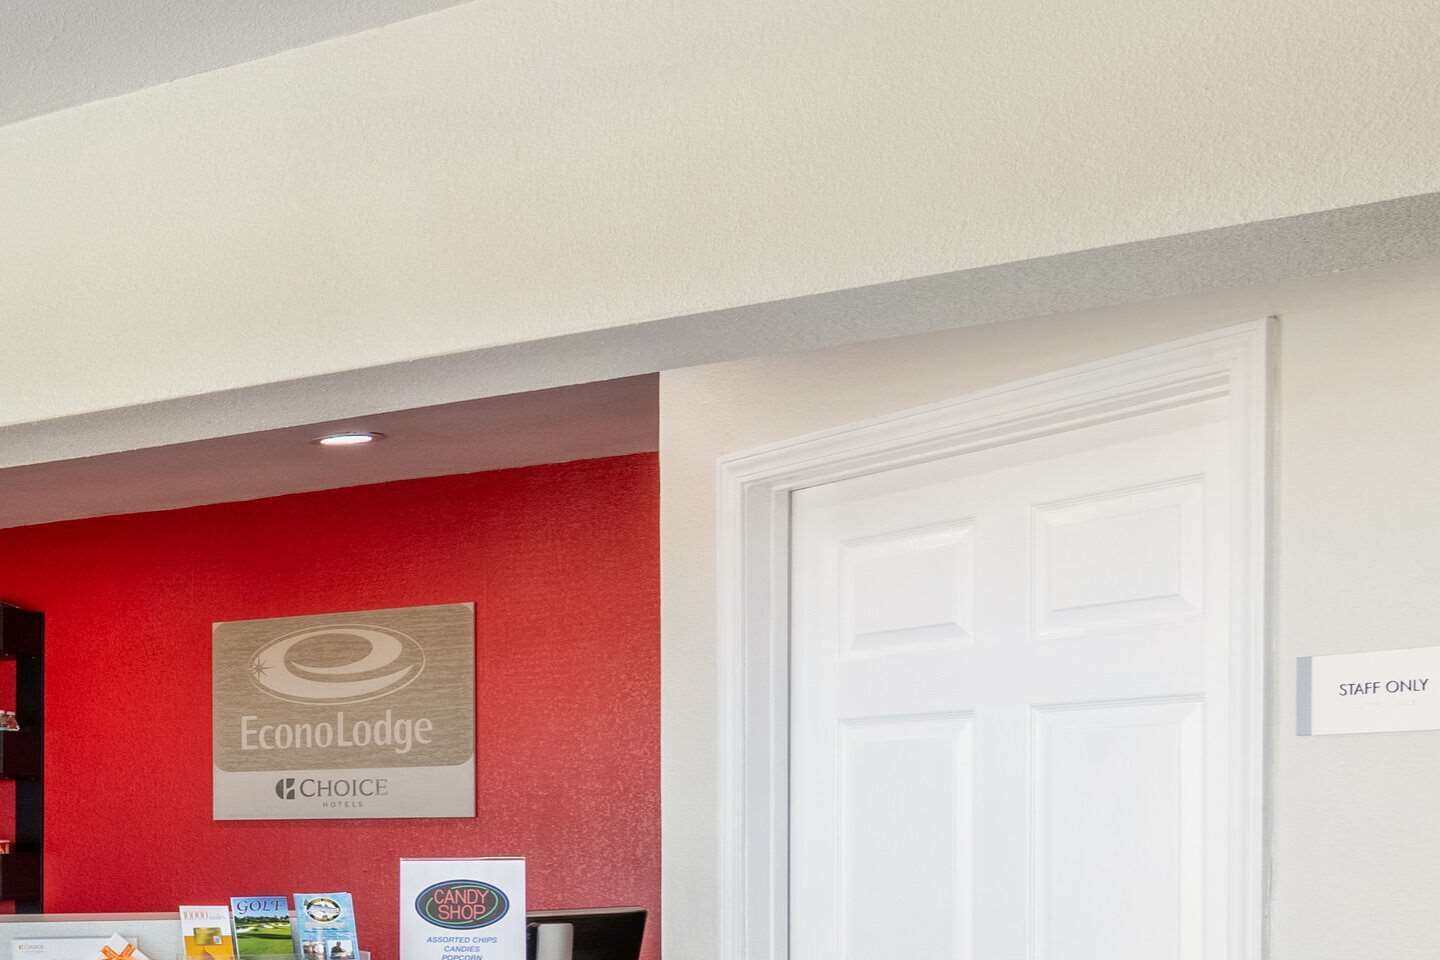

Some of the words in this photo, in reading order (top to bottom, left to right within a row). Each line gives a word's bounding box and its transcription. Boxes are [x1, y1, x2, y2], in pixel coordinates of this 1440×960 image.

[1339, 681, 1380, 697] STAFF
[1385, 678, 1429, 694] ONLY
[240, 709, 433, 754] EconoLodge
[299, 778, 389, 800] CHOICE
[322, 801, 364, 809] HOTELS
[433, 889, 489, 905] CANDY
[437, 904, 486, 920] SHOP
[426, 936, 471, 944] ASSORTED
[472, 936, 498, 944] CHIPS
[443, 945, 481, 953] CANDIES
